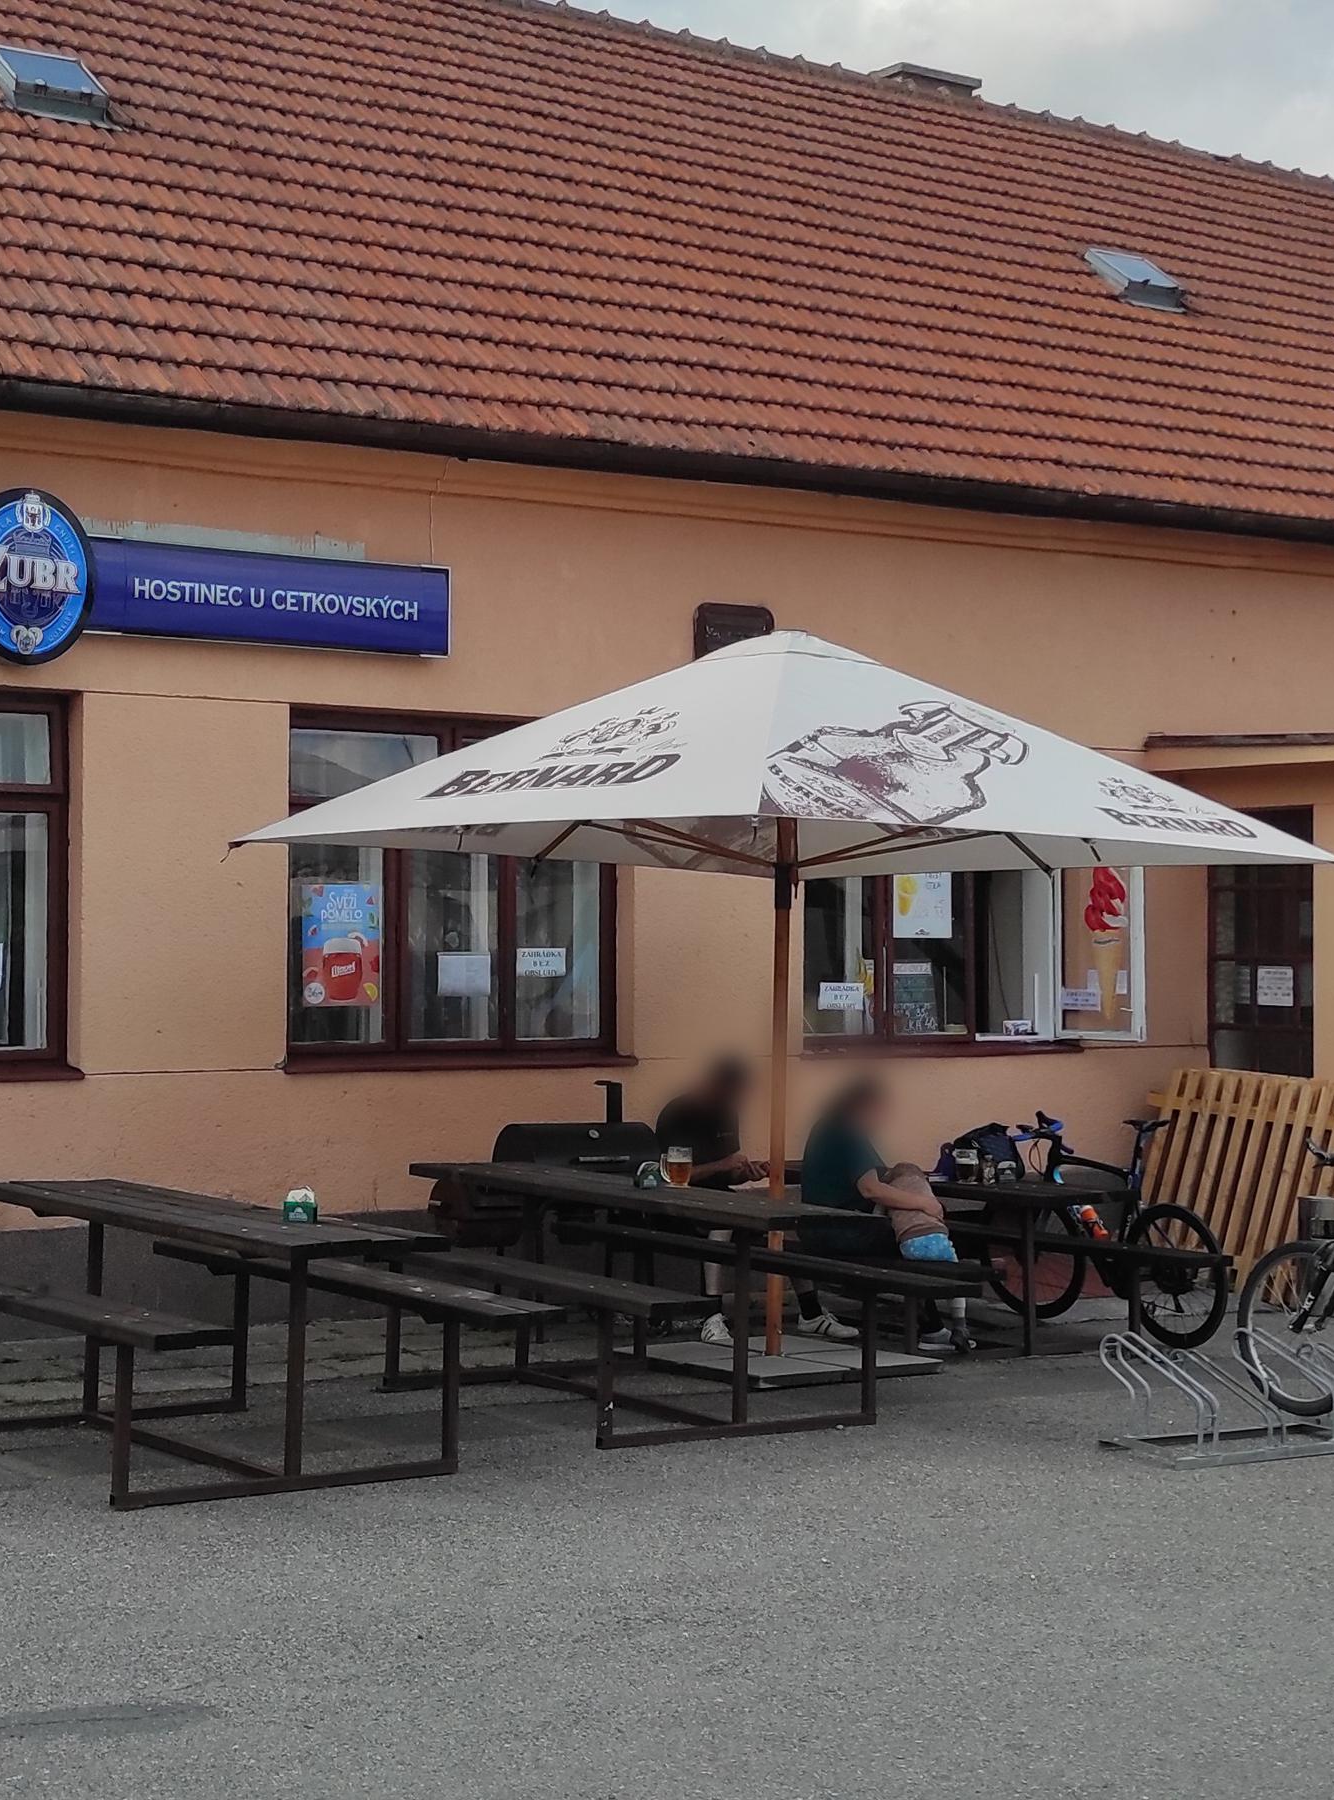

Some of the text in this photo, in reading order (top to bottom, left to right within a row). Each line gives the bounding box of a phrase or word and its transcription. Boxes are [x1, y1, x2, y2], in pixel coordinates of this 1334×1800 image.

[133, 577, 419, 621] HOSTINEC U CETKOVSKÝCH
[420, 753, 681, 799] BERNARD
[1095, 806, 1258, 838] BERNARD
